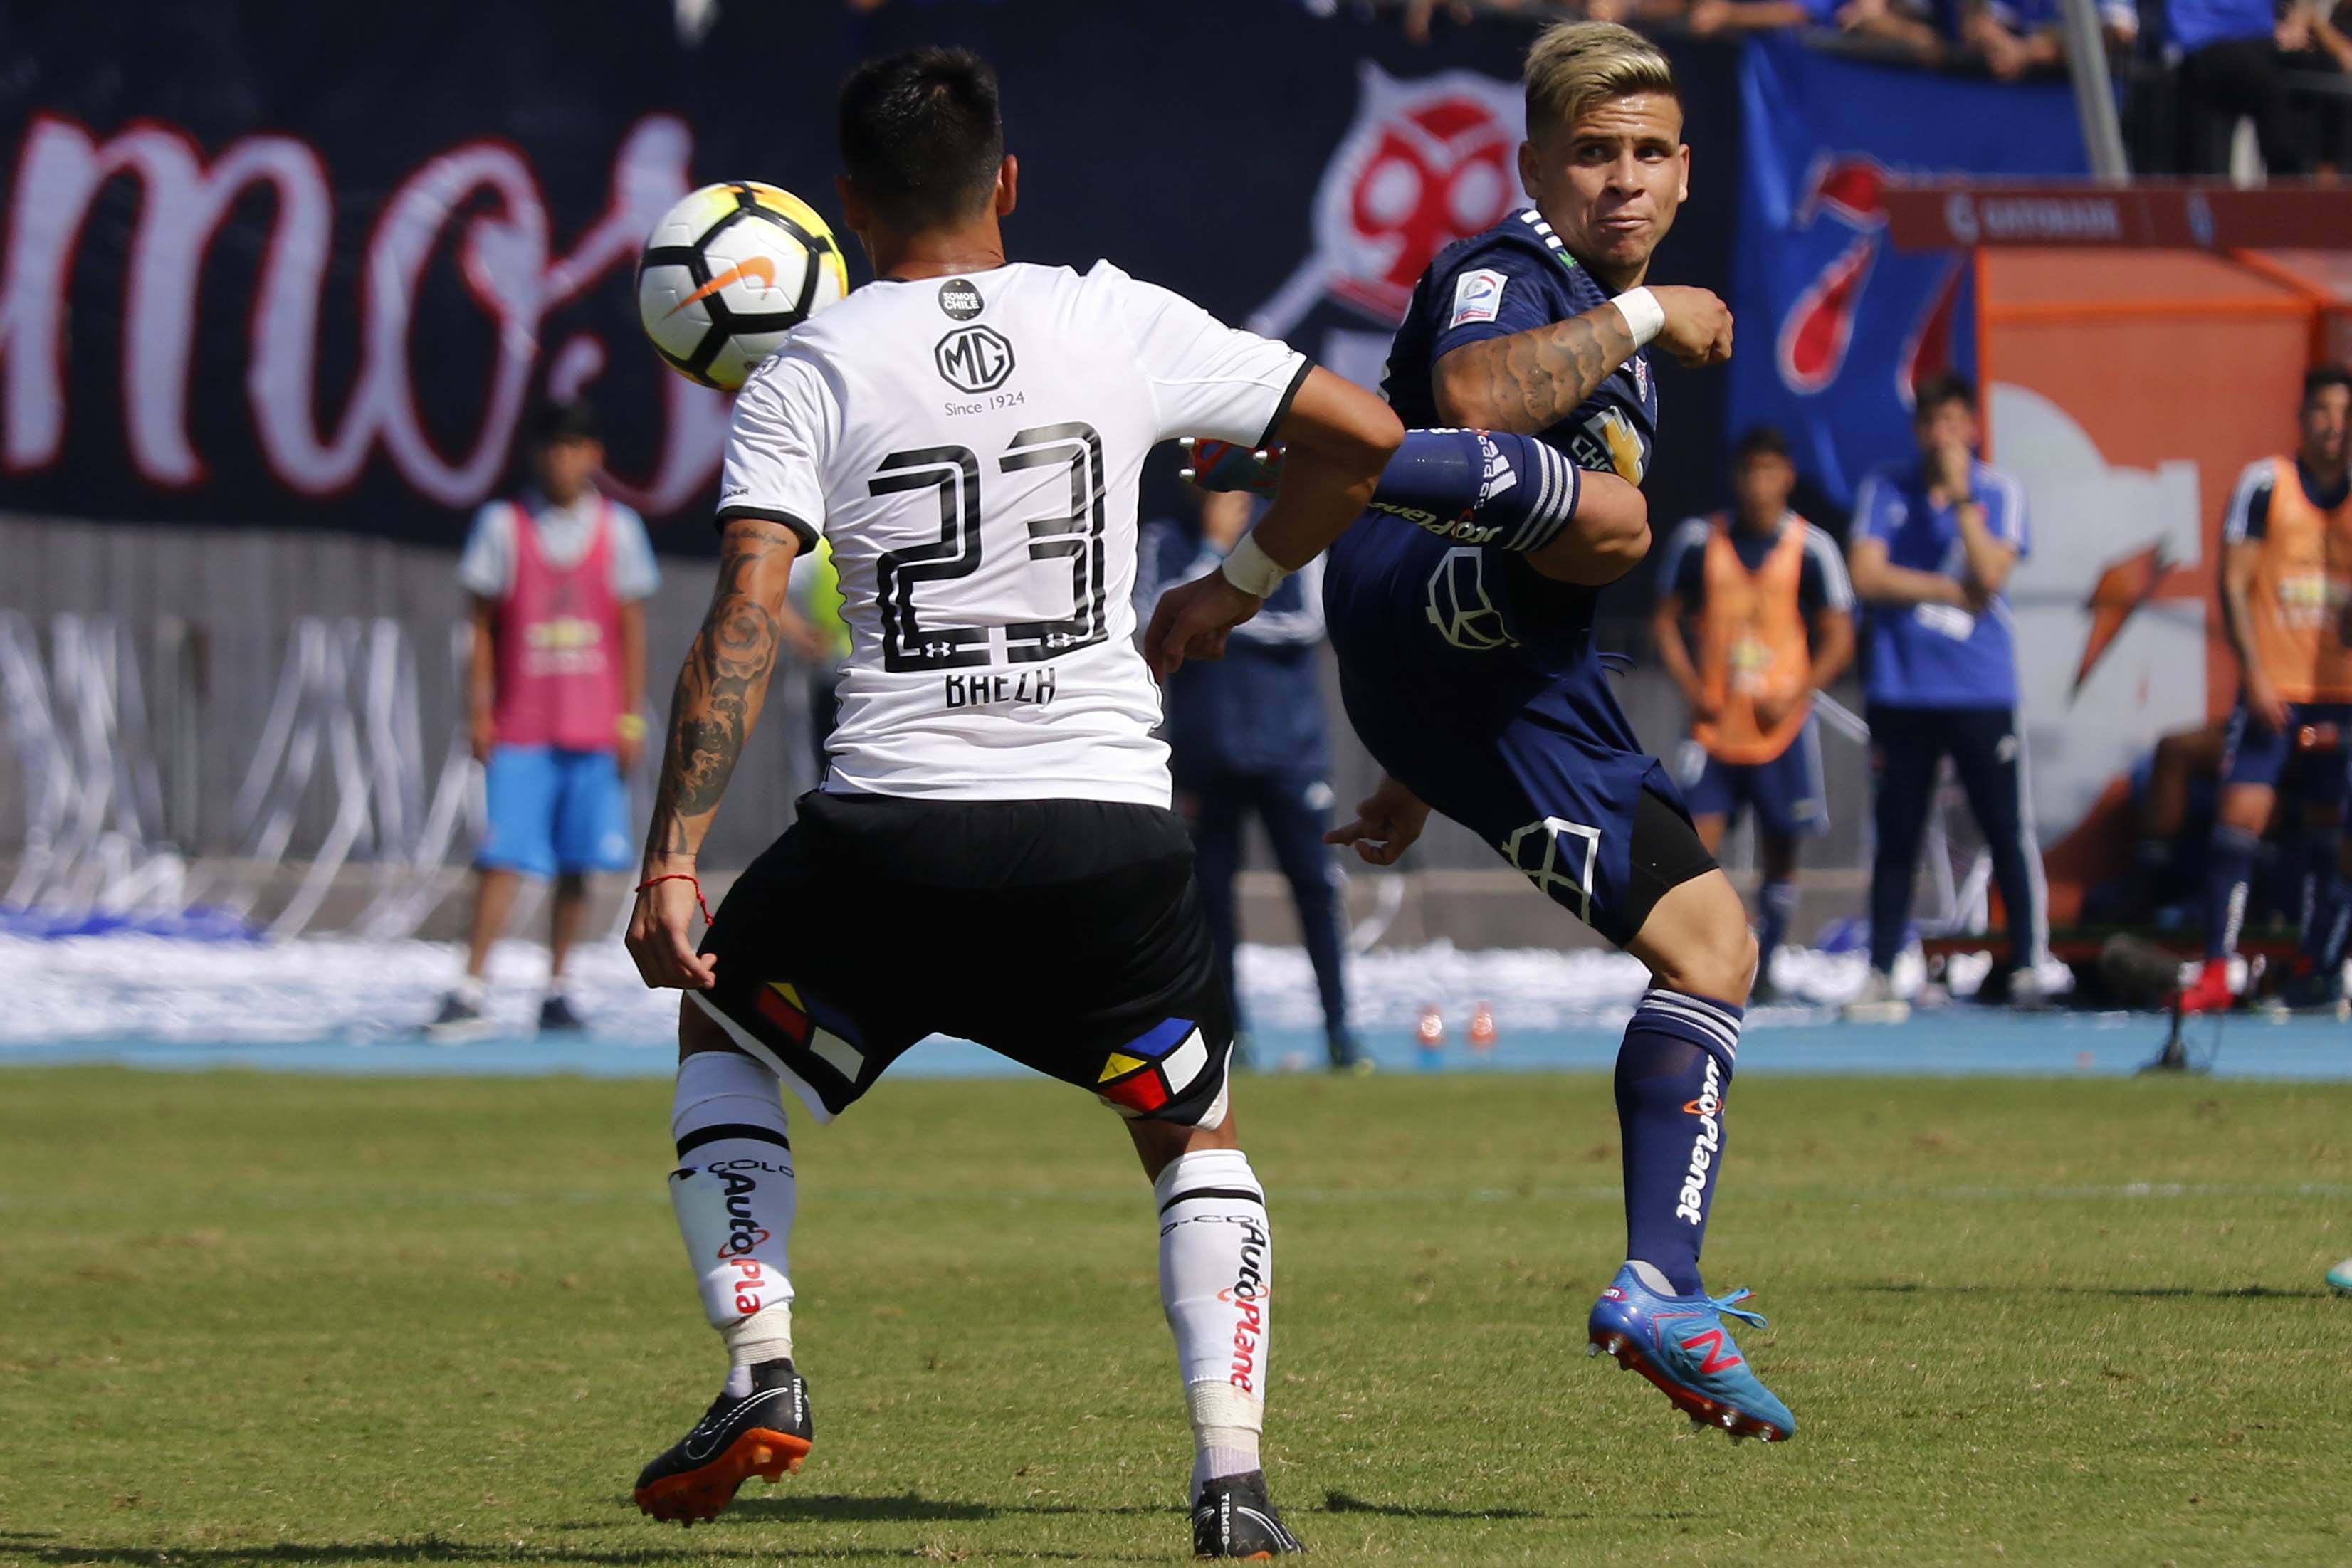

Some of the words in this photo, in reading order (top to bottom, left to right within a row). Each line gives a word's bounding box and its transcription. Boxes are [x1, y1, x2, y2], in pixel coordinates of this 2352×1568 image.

[943, 292, 976, 301] SOMOS
[944, 300, 980, 310] CHILE
[944, 331, 1005, 386] MG
[945, 402, 982, 416] Since
[989, 391, 1025, 410] 1924
[868, 421, 1109, 673] 23
[1676, 1054, 1720, 1225] utoPlanet
[792, 1378, 803, 1422] TIEMPO
[1221, 1493, 1230, 1545] TIEMPO
